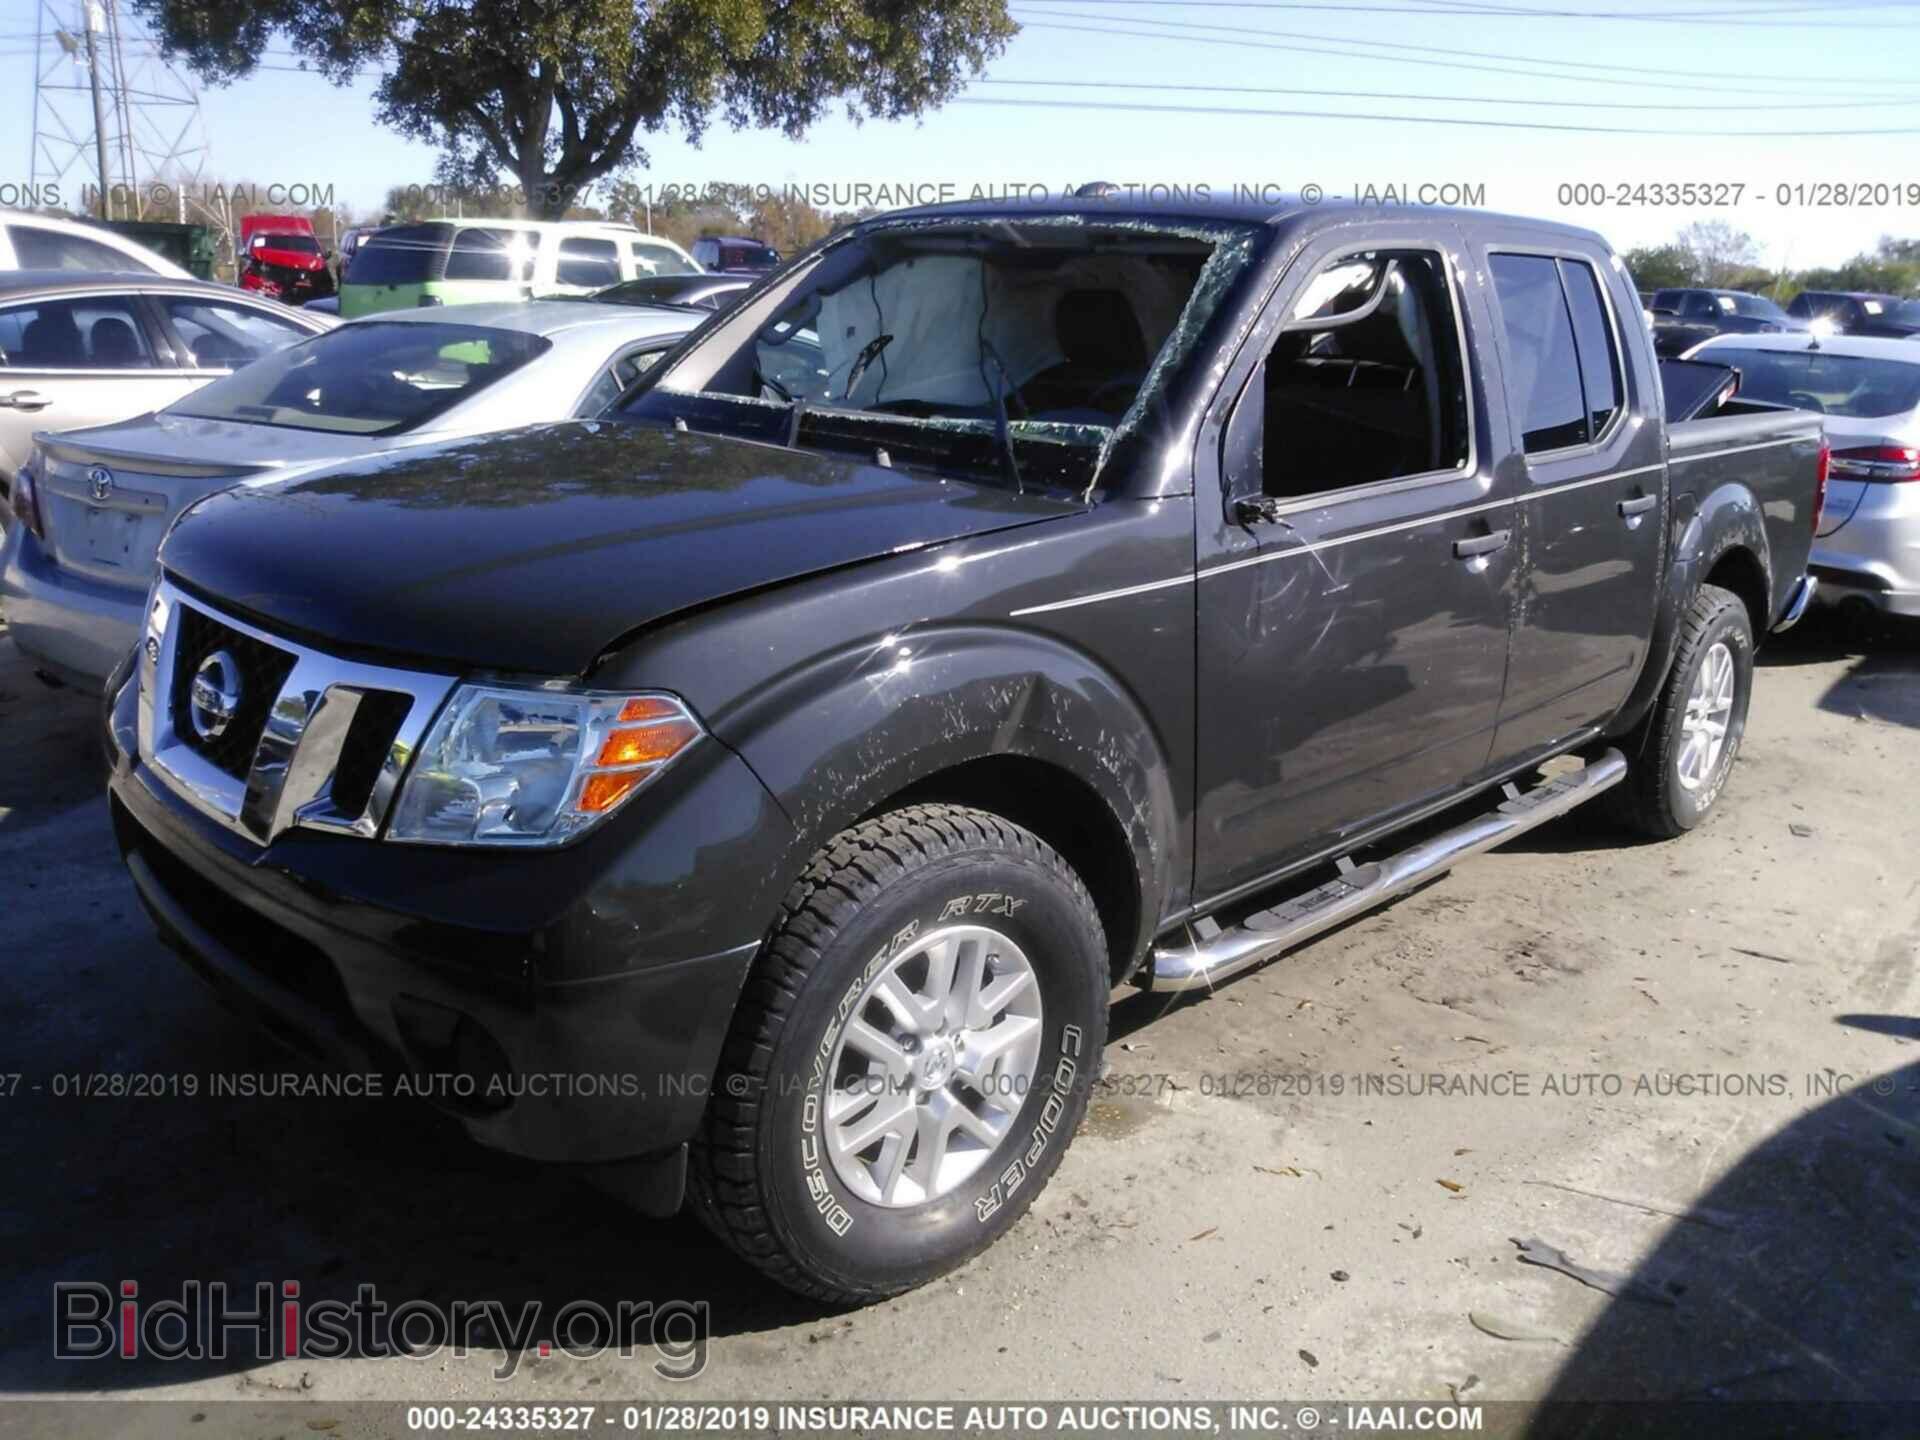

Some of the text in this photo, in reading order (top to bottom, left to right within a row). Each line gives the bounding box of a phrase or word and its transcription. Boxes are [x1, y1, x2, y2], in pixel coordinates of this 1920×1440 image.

[802, 893, 1028, 1237] DISCOVERER RTX
[973, 1024, 1082, 1223] COOPER
